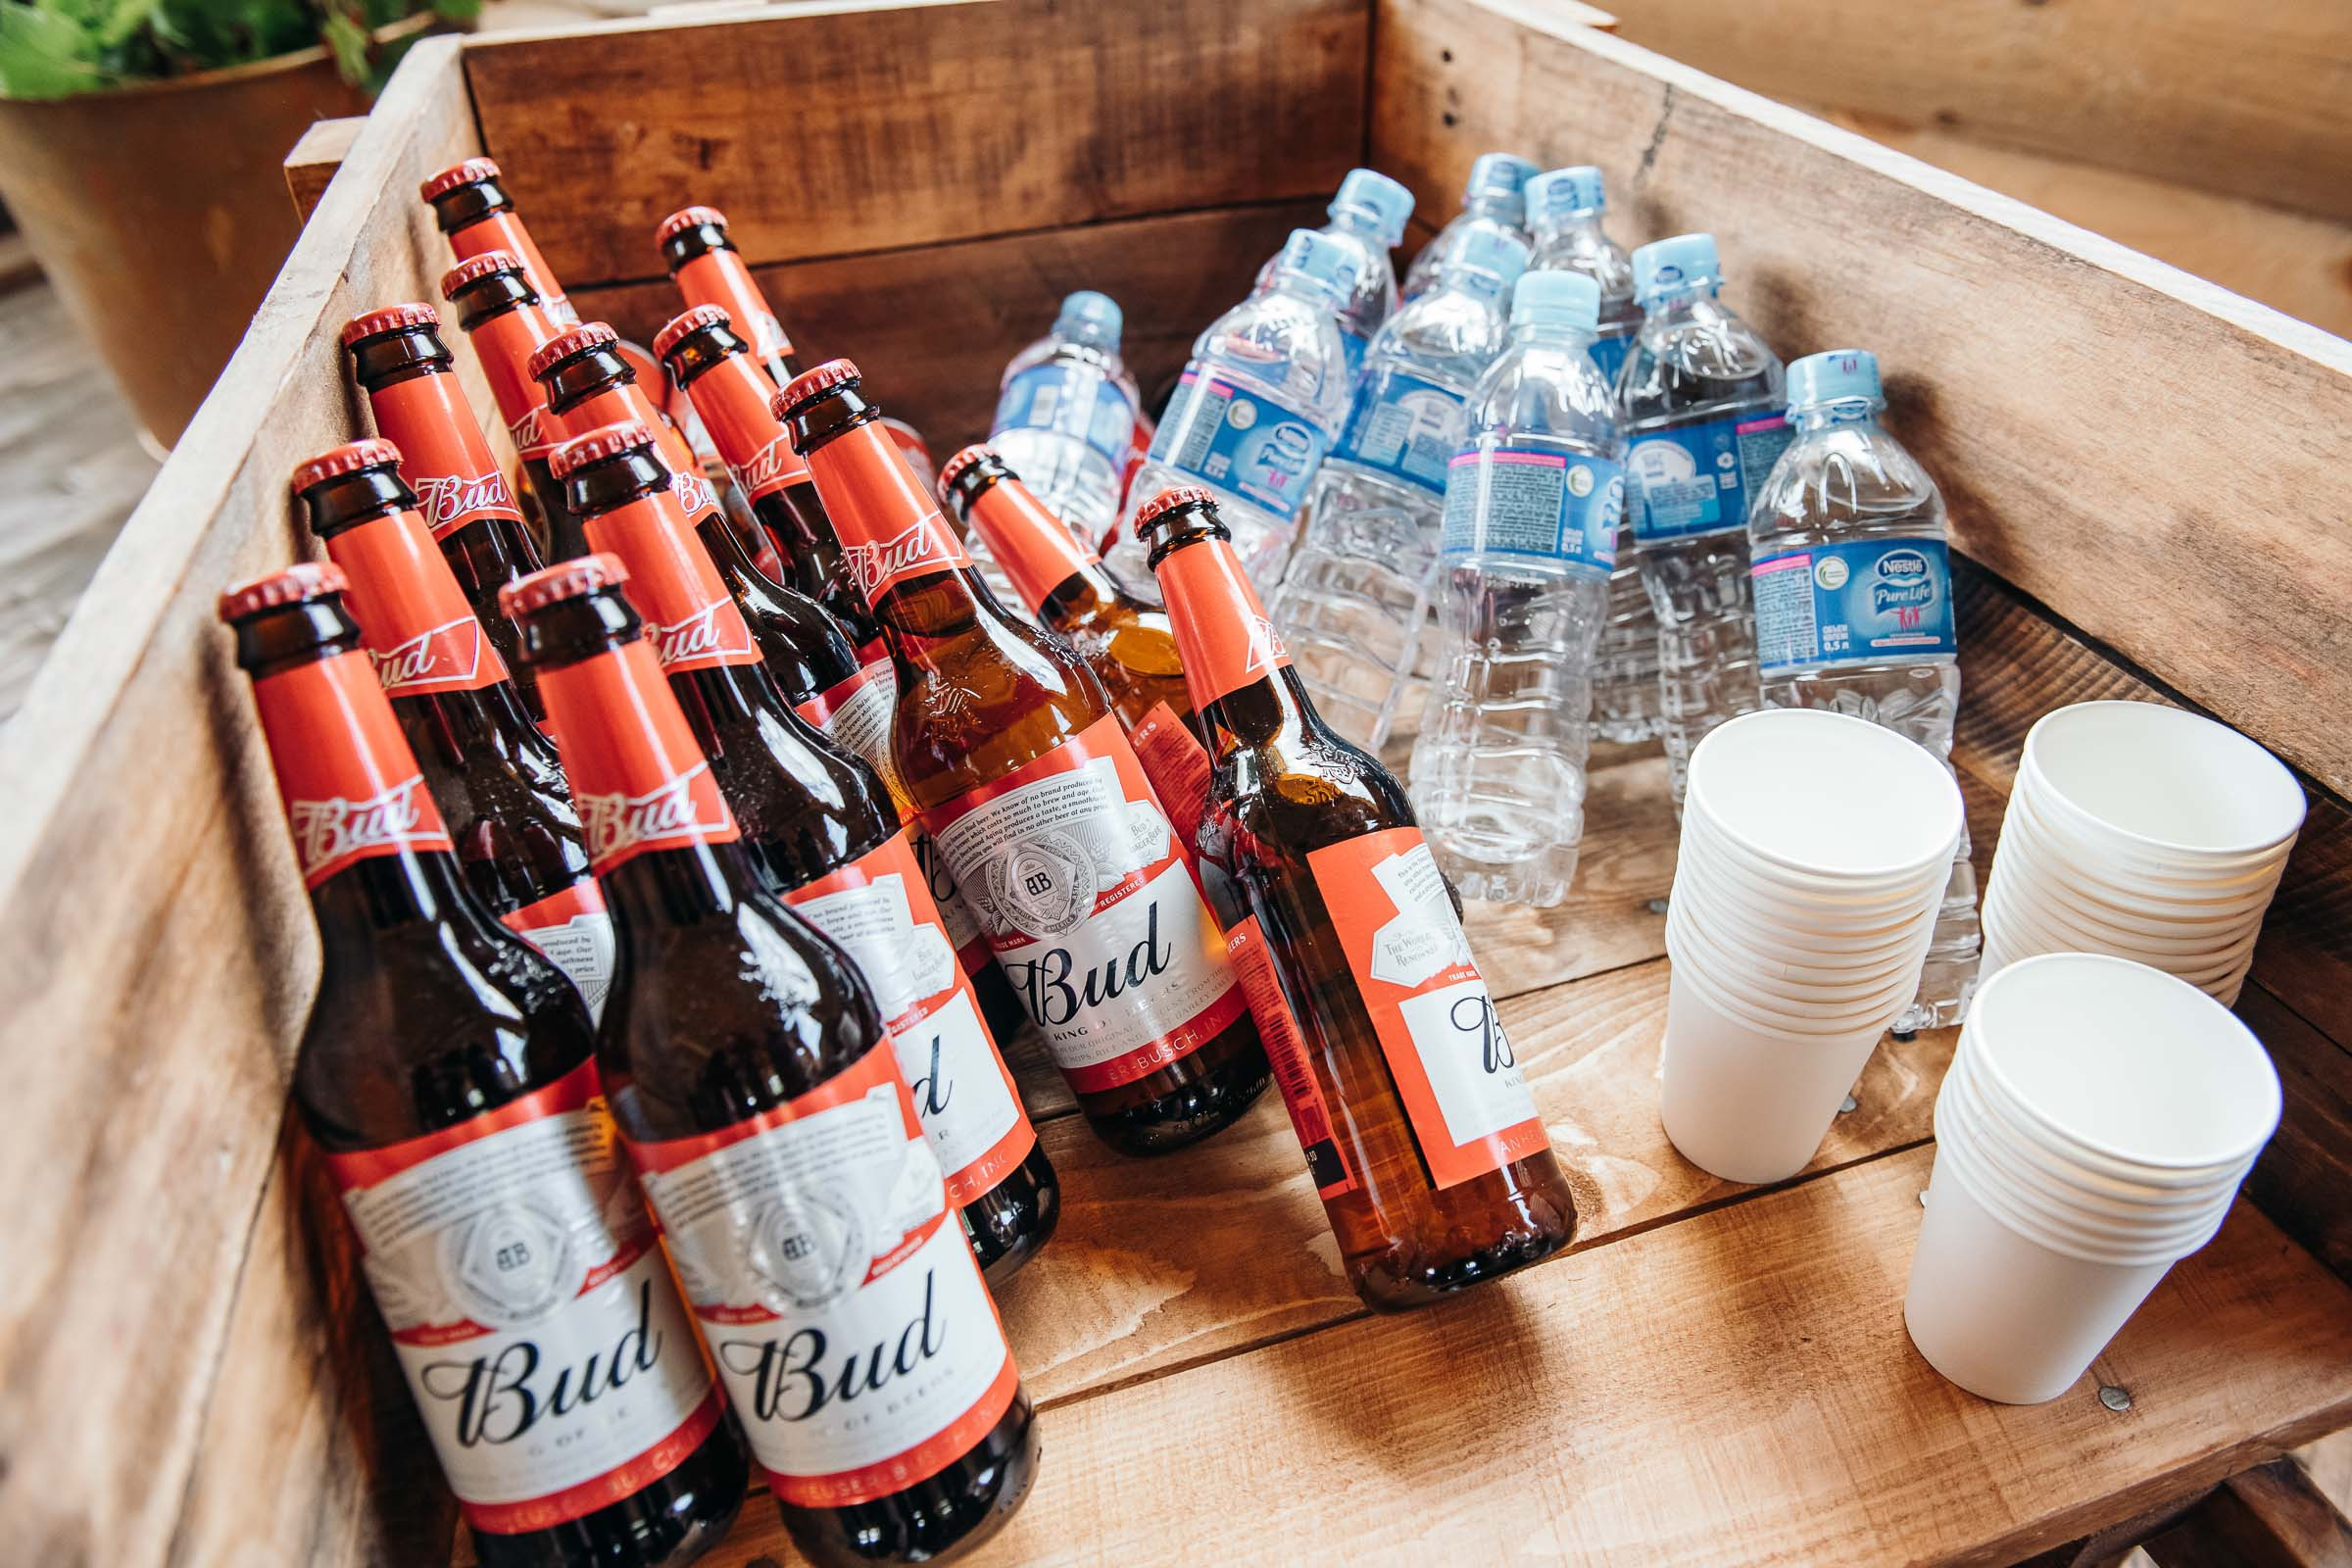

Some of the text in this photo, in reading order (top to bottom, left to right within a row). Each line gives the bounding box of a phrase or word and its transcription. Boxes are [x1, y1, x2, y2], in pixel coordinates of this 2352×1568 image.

[512, 408, 543, 449] ud
[413, 470, 508, 527] Bud
[848, 524, 933, 592] Bud
[1877, 584, 1932, 605] Pure Life
[368, 631, 436, 689] ud
[1134, 721, 1157, 748] ERS
[578, 777, 698, 855] Bud
[970, 827, 986, 840] which
[987, 819, 1003, 830] costs
[1012, 806, 1032, 816] much
[1042, 797, 1059, 806] brew
[1002, 801, 1020, 813] know
[1020, 796, 1029, 805] of
[1041, 786, 1061, 798] brand
[292, 785, 420, 863] Bud
[985, 829, 1003, 842] Aging
[1004, 815, 1034, 833] produces
[1042, 806, 1061, 815] taste,
[993, 837, 1004, 846] will
[1004, 830, 1017, 842] find
[1036, 816, 1054, 827] other
[1100, 877, 1145, 907] REGISTERED
[1005, 902, 1170, 1027] Bud
[1228, 933, 1247, 954] LERS
[1054, 1027, 1088, 1042] KING
[422, 1279, 663, 1447] Bud
[720, 1269, 948, 1422] Bud
